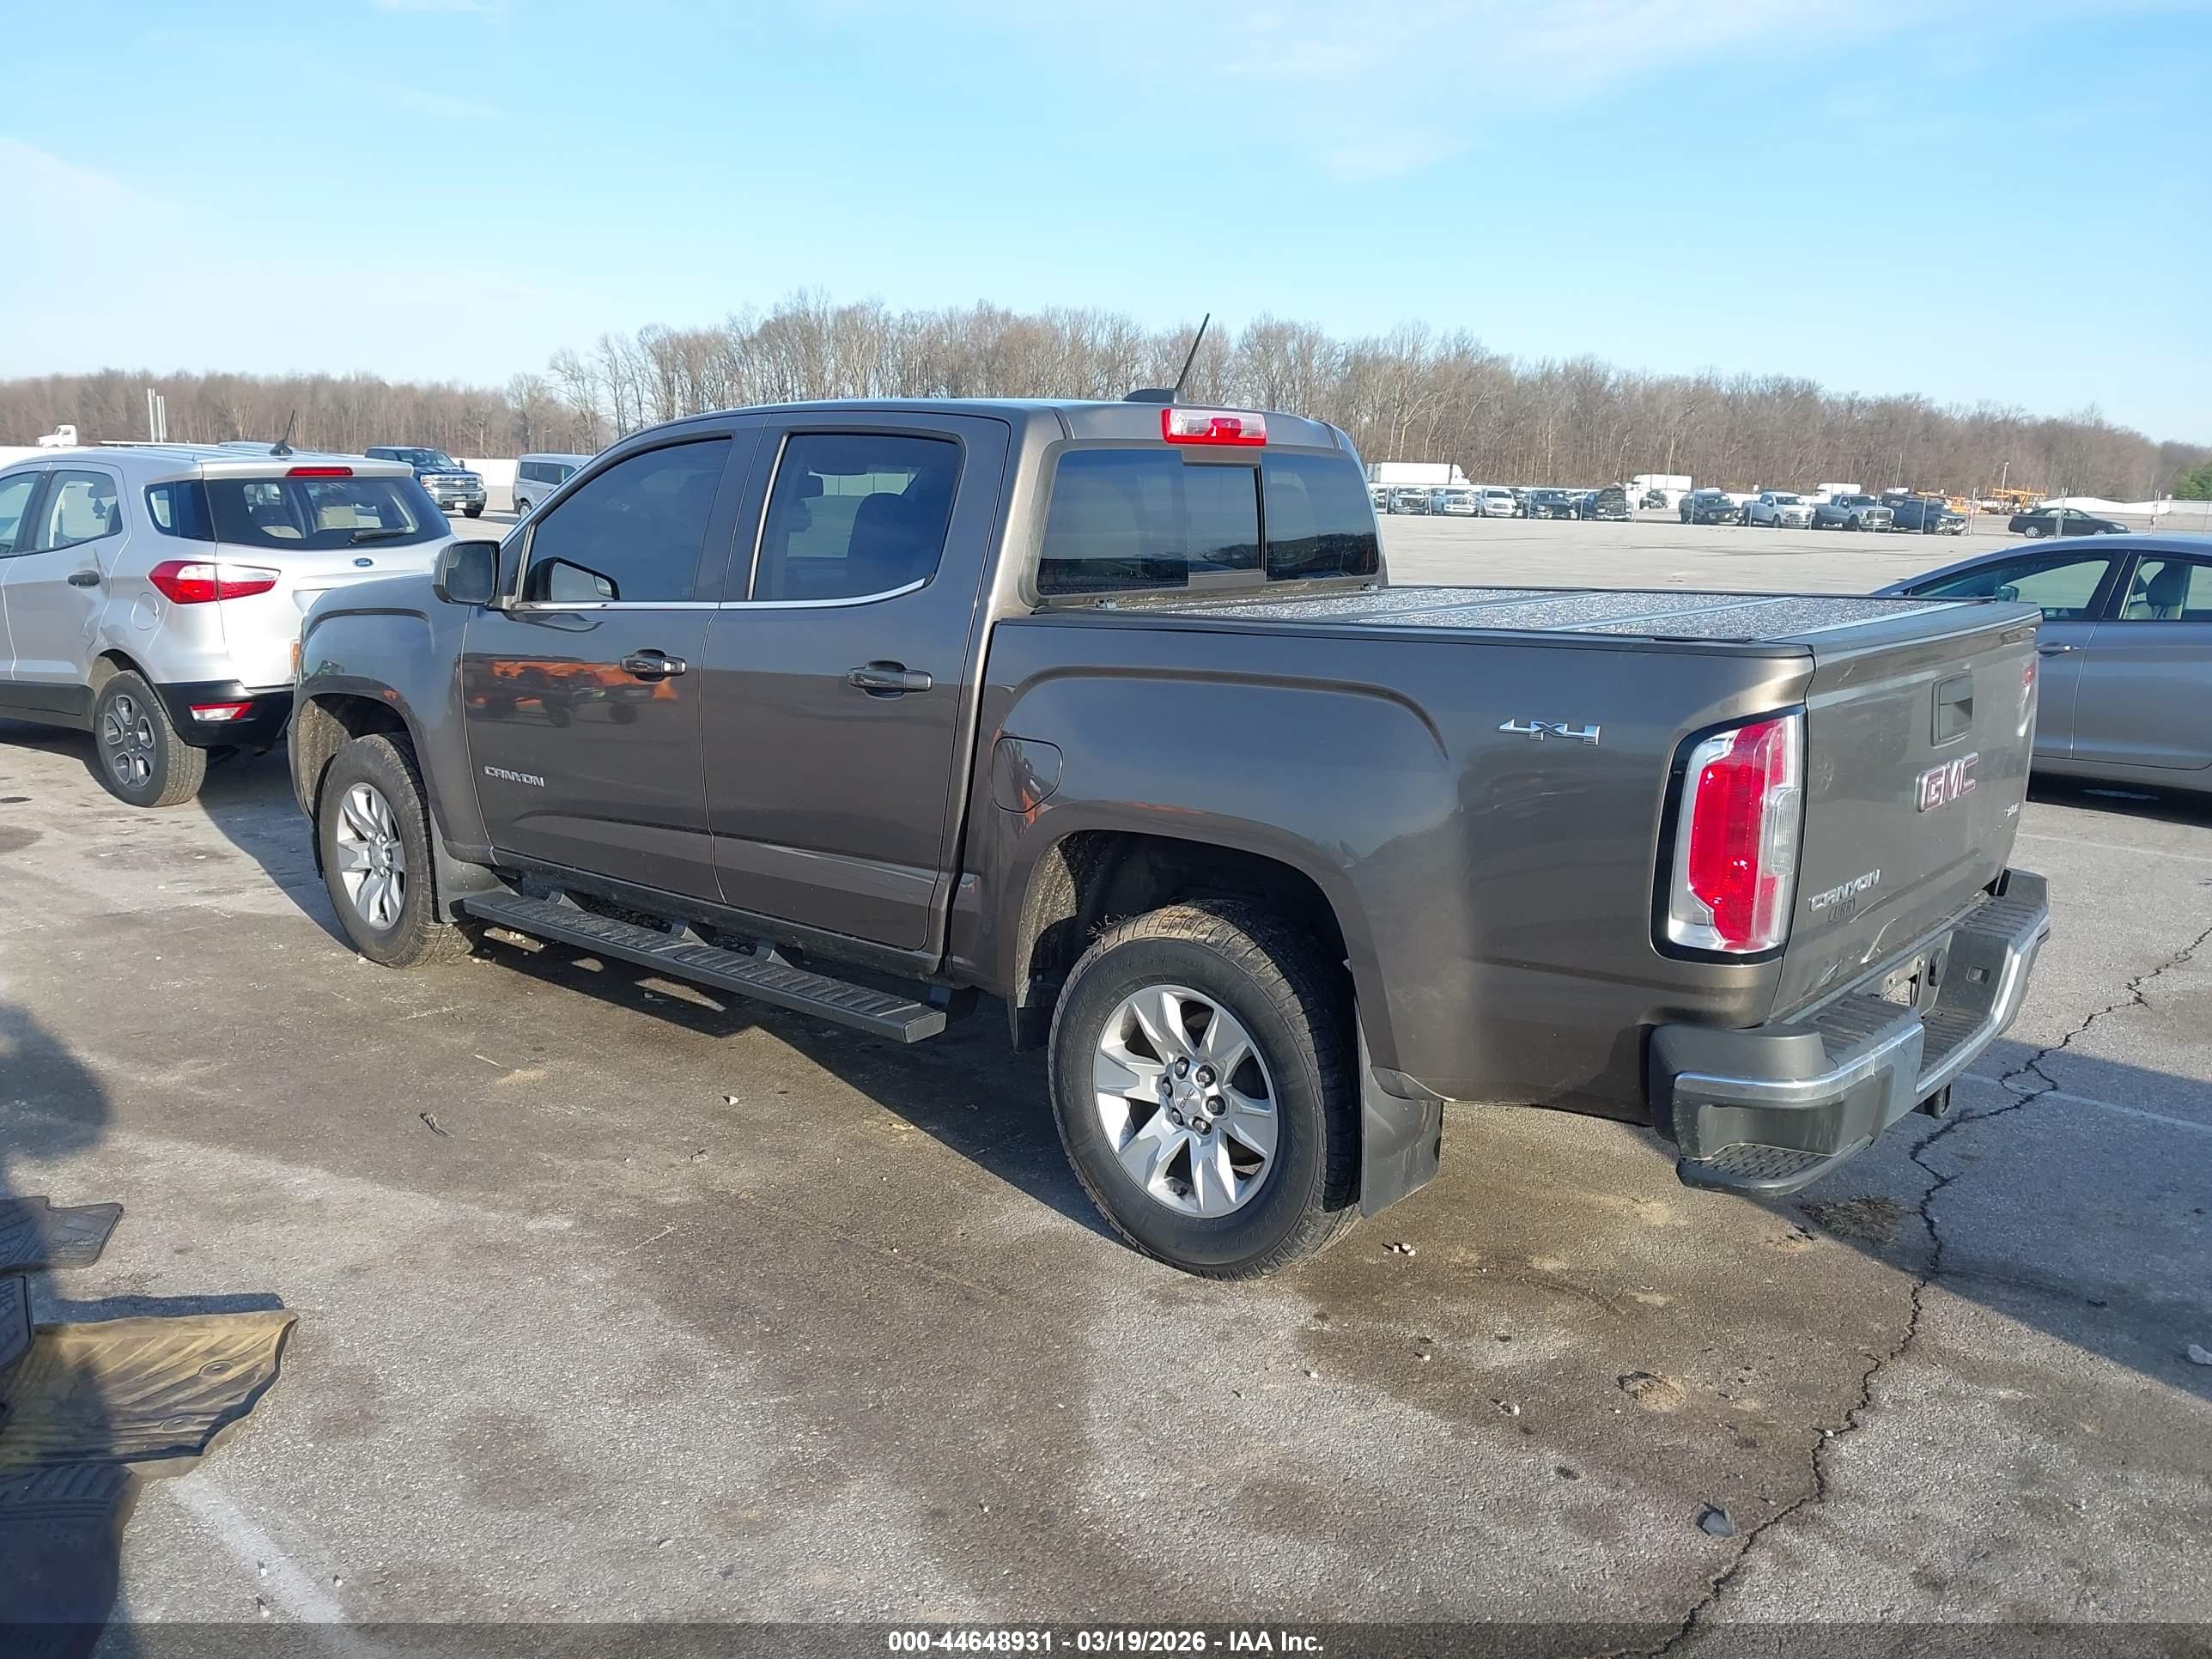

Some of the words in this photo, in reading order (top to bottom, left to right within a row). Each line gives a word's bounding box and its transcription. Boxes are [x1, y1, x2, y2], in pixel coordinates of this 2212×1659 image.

[483, 765, 544, 787] CANYON
[1914, 751, 1979, 812] GMC
[1808, 868, 1881, 912] CANYON
[1179, 1086, 1196, 1109] GMC
